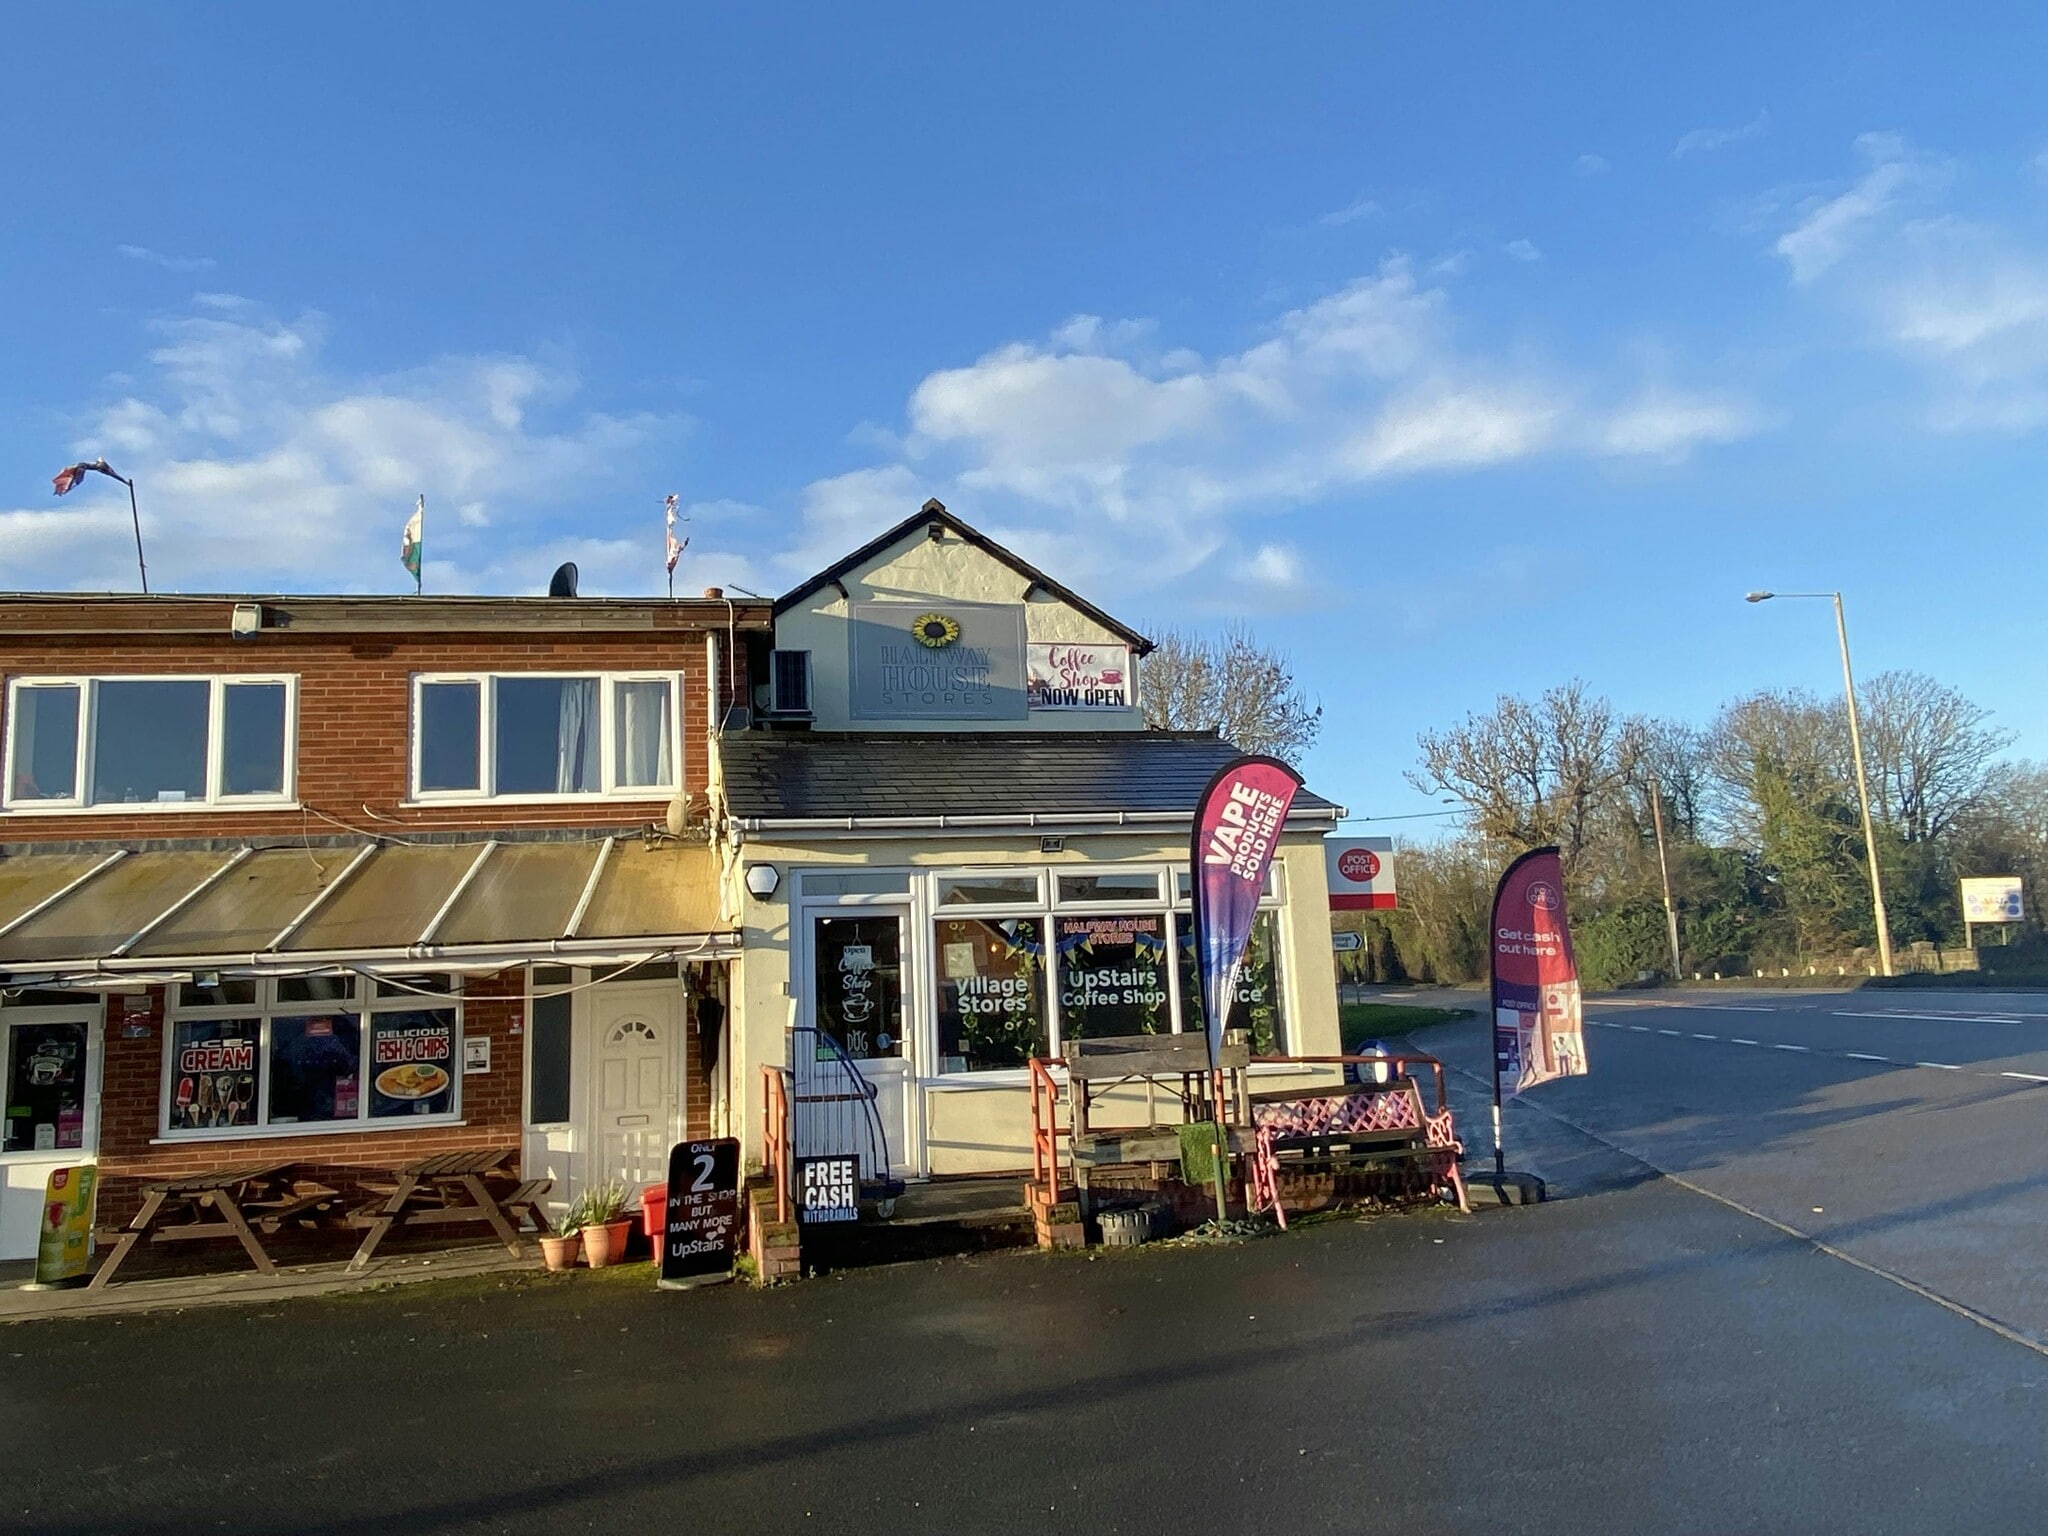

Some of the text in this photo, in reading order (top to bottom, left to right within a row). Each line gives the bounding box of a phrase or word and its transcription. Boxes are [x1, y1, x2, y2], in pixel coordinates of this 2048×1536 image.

[880, 646, 991, 666] HALFWAY
[1048, 646, 1096, 671] Coffee
[882, 664, 991, 692] HOUSE
[1060, 668, 1099, 691] Shop
[882, 691, 993, 705] STORES
[1041, 688, 1125, 706] NOW OPEN
[1204, 781, 1260, 866] VAPE
[1230, 792, 1272, 875] PRODUCTS
[1242, 796, 1285, 881] SOLD HERE
[1341, 864, 1377, 874] OFFICE
[1346, 855, 1371, 865] POST
[1497, 928, 1560, 943] Get cash
[1498, 943, 1557, 956] out here
[842, 973, 873, 993] Shop
[955, 975, 1028, 997] Village
[1068, 968, 1157, 992] UpStairs
[957, 995, 1027, 1014] Stores
[1060, 989, 1167, 1007] Coffee Shop
[376, 1027, 449, 1039] DELICIOUS
[376, 1038, 403, 1063] FISH
[404, 1038, 414, 1061] &
[415, 1036, 449, 1060] CHIPS
[181, 1047, 253, 1073] CREAM
[691, 1154, 715, 1192] 2
[805, 1161, 853, 1187] FREE
[669, 1196, 681, 1208] IN
[684, 1193, 703, 1205] THE
[805, 1185, 853, 1210] CASH
[691, 1204, 713, 1217] BUT
[803, 1207, 859, 1224] WITHDRAWALS
[669, 1214, 733, 1233] MANY MORE
[672, 1239, 724, 1258] UpStairs
